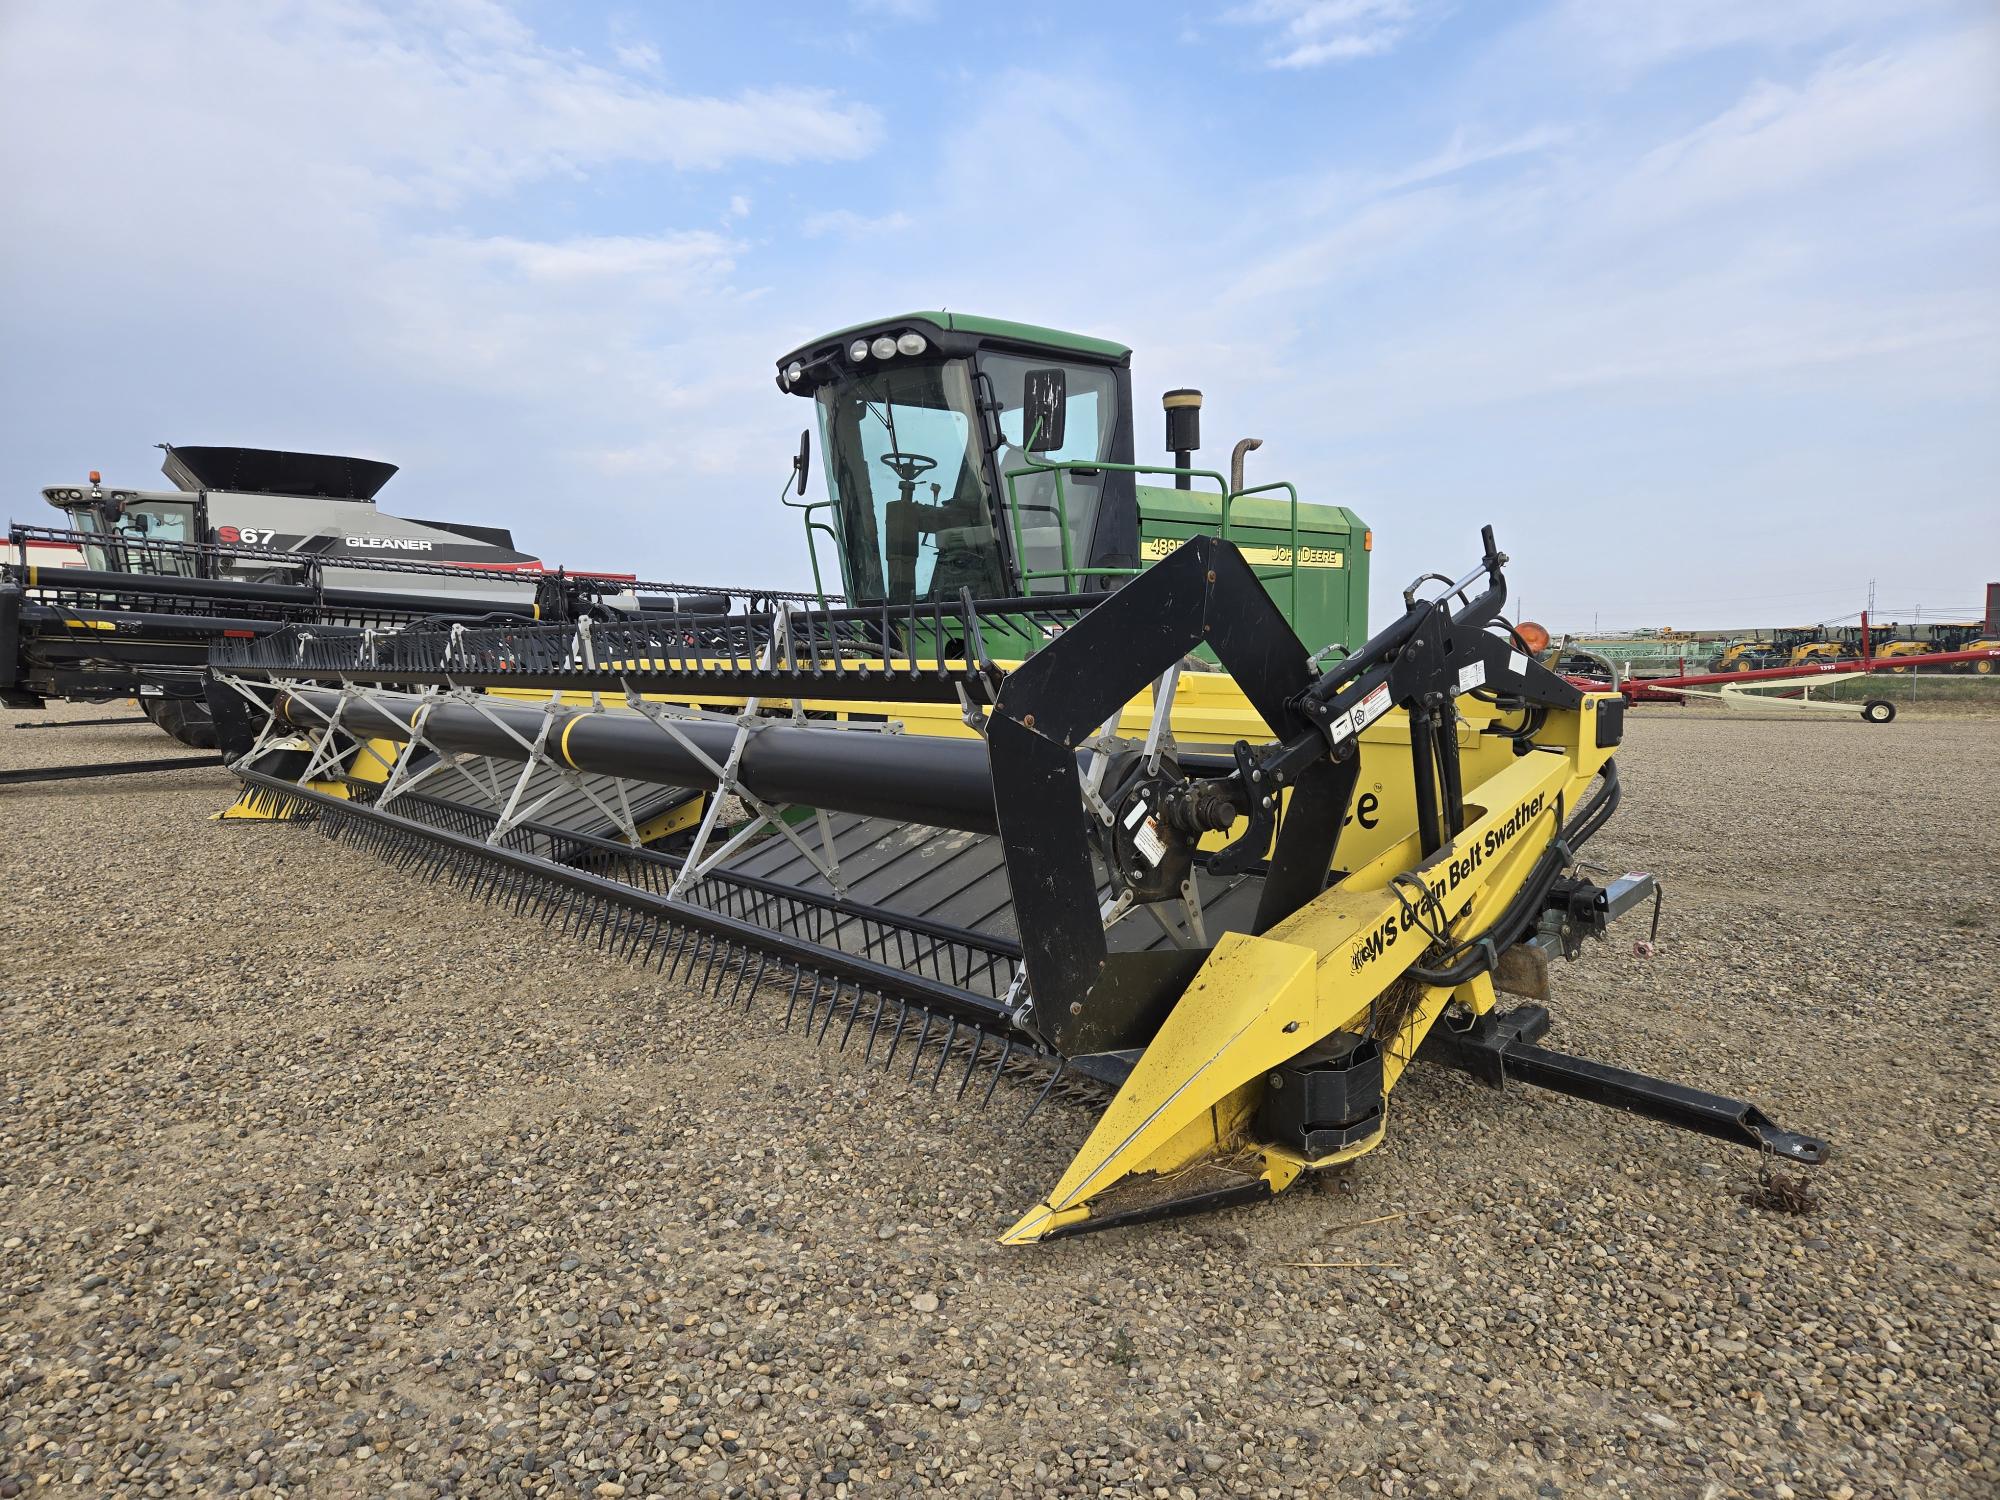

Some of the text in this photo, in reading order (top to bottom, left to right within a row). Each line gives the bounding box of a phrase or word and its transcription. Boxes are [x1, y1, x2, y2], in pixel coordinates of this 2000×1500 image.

[218, 525, 276, 545] S67
[345, 536, 432, 551] GLEANER
[1302, 546, 1336, 563] DEERE
[1366, 791, 1545, 962] WS Grain Belt Swather
